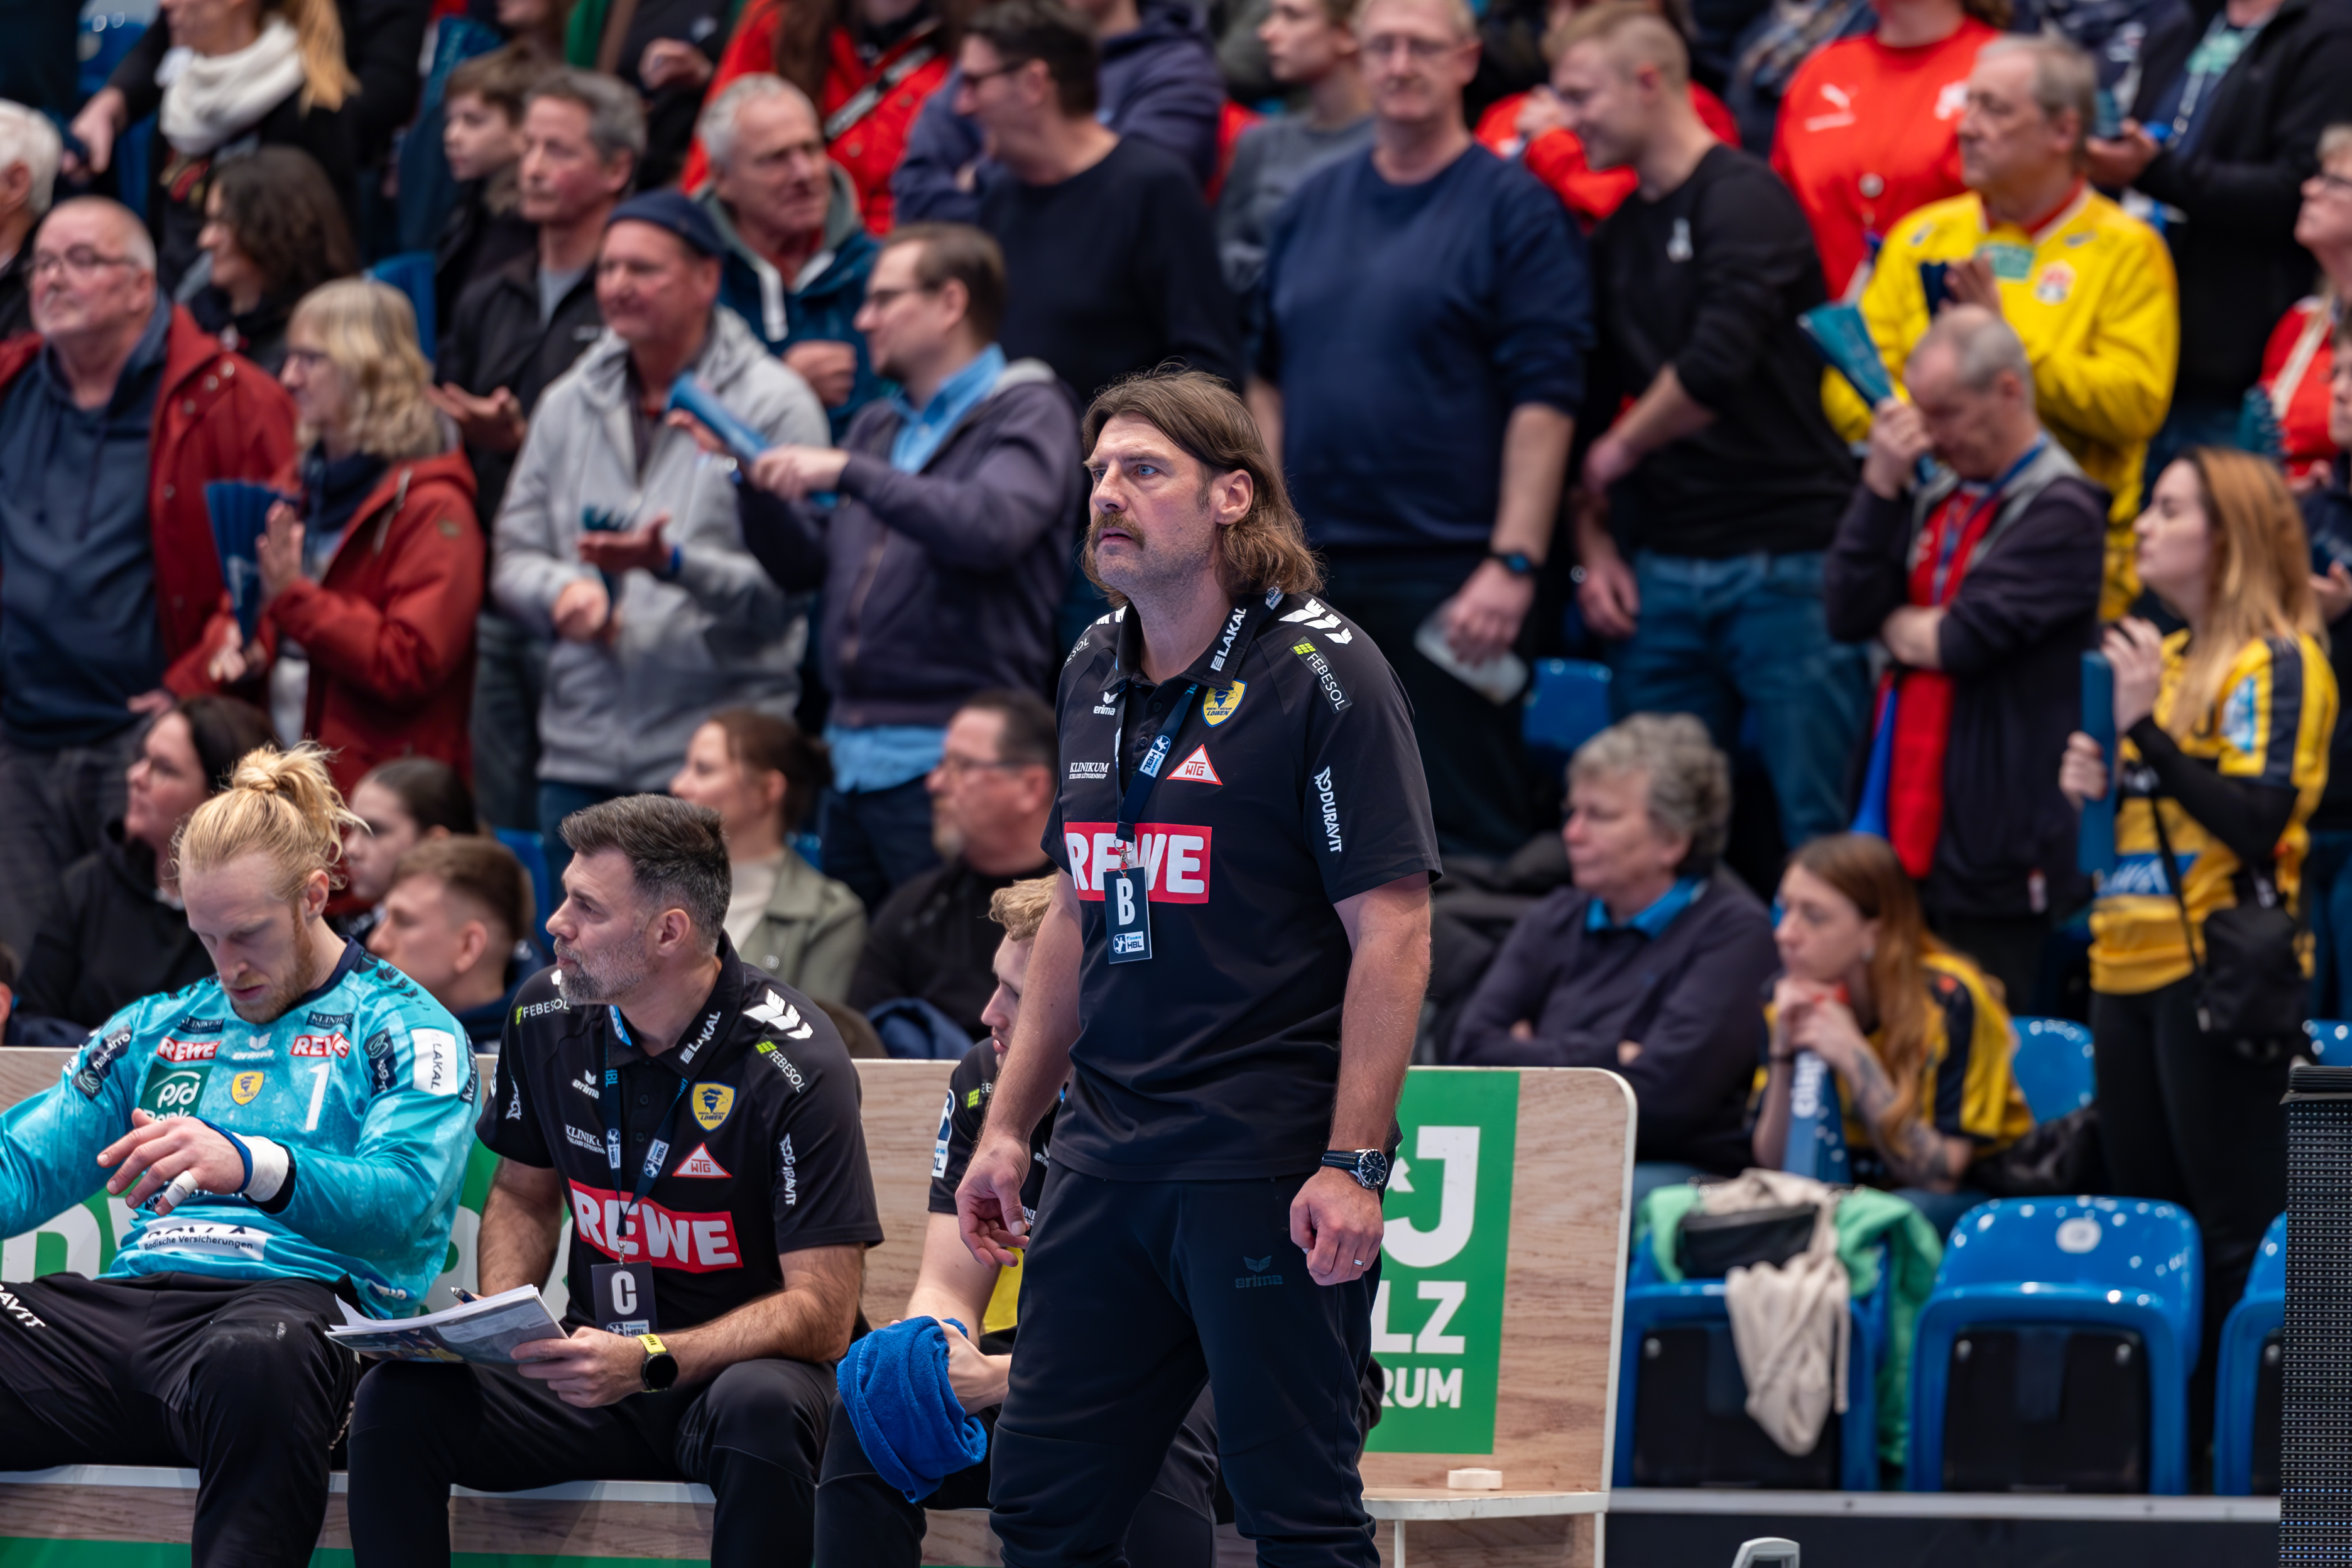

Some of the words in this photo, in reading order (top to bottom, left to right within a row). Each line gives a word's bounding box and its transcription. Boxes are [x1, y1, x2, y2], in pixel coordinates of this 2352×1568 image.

[1307, 653, 1345, 710] FEBESOL
[1093, 705, 1116, 716] erima
[1069, 762, 1110, 773] KLINIKUM
[1143, 751, 1158, 770] HBL
[1185, 761, 1206, 776] WTG
[1320, 791, 1342, 852] DURAVIT
[1065, 832, 1206, 894] REWE
[1116, 878, 1136, 926] B
[1127, 940, 1143, 950] HBL
[523, 998, 570, 1019] FEBESOL
[159, 1038, 216, 1061] REWE
[232, 1049, 275, 1060] erima
[769, 1050, 805, 1093] FEBESOL
[156, 1082, 201, 1109] psd
[306, 1062, 330, 1131] 1
[572, 1079, 600, 1099] erima
[655, 1145, 667, 1163] HBL
[691, 1158, 711, 1173] WTG
[572, 1189, 738, 1266] REWE
[144, 1236, 177, 1251] Badische
[178, 1235, 253, 1250] Versicherungen
[611, 1270, 638, 1315] C
[1235, 1275, 1283, 1288] erima
[0, 1283, 46, 1327] AVIT
[1371, 1280, 1467, 1354] LZ
[1381, 1367, 1463, 1408] RUM
